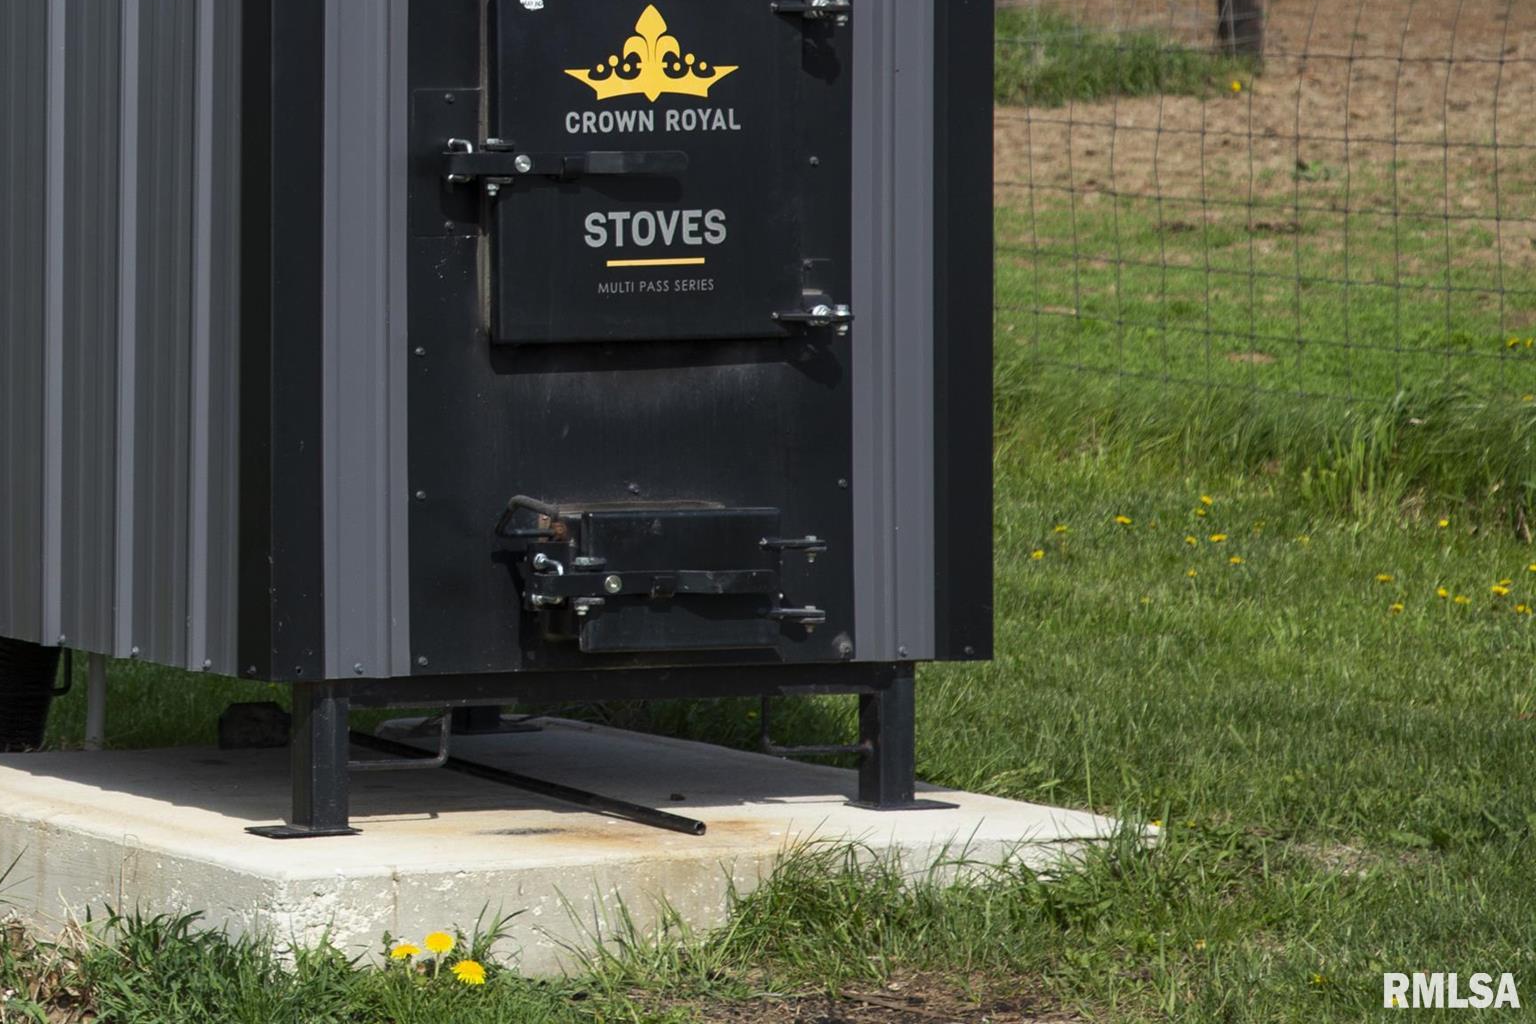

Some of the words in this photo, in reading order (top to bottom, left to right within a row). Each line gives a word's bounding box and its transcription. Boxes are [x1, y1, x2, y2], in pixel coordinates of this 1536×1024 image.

[565, 110, 654, 134] CROWN
[666, 108, 741, 132] ROYAL
[584, 209, 727, 248] STOVES
[598, 281, 634, 294] MULTI
[640, 280, 669, 293] PASS
[674, 278, 714, 292] SERIES
